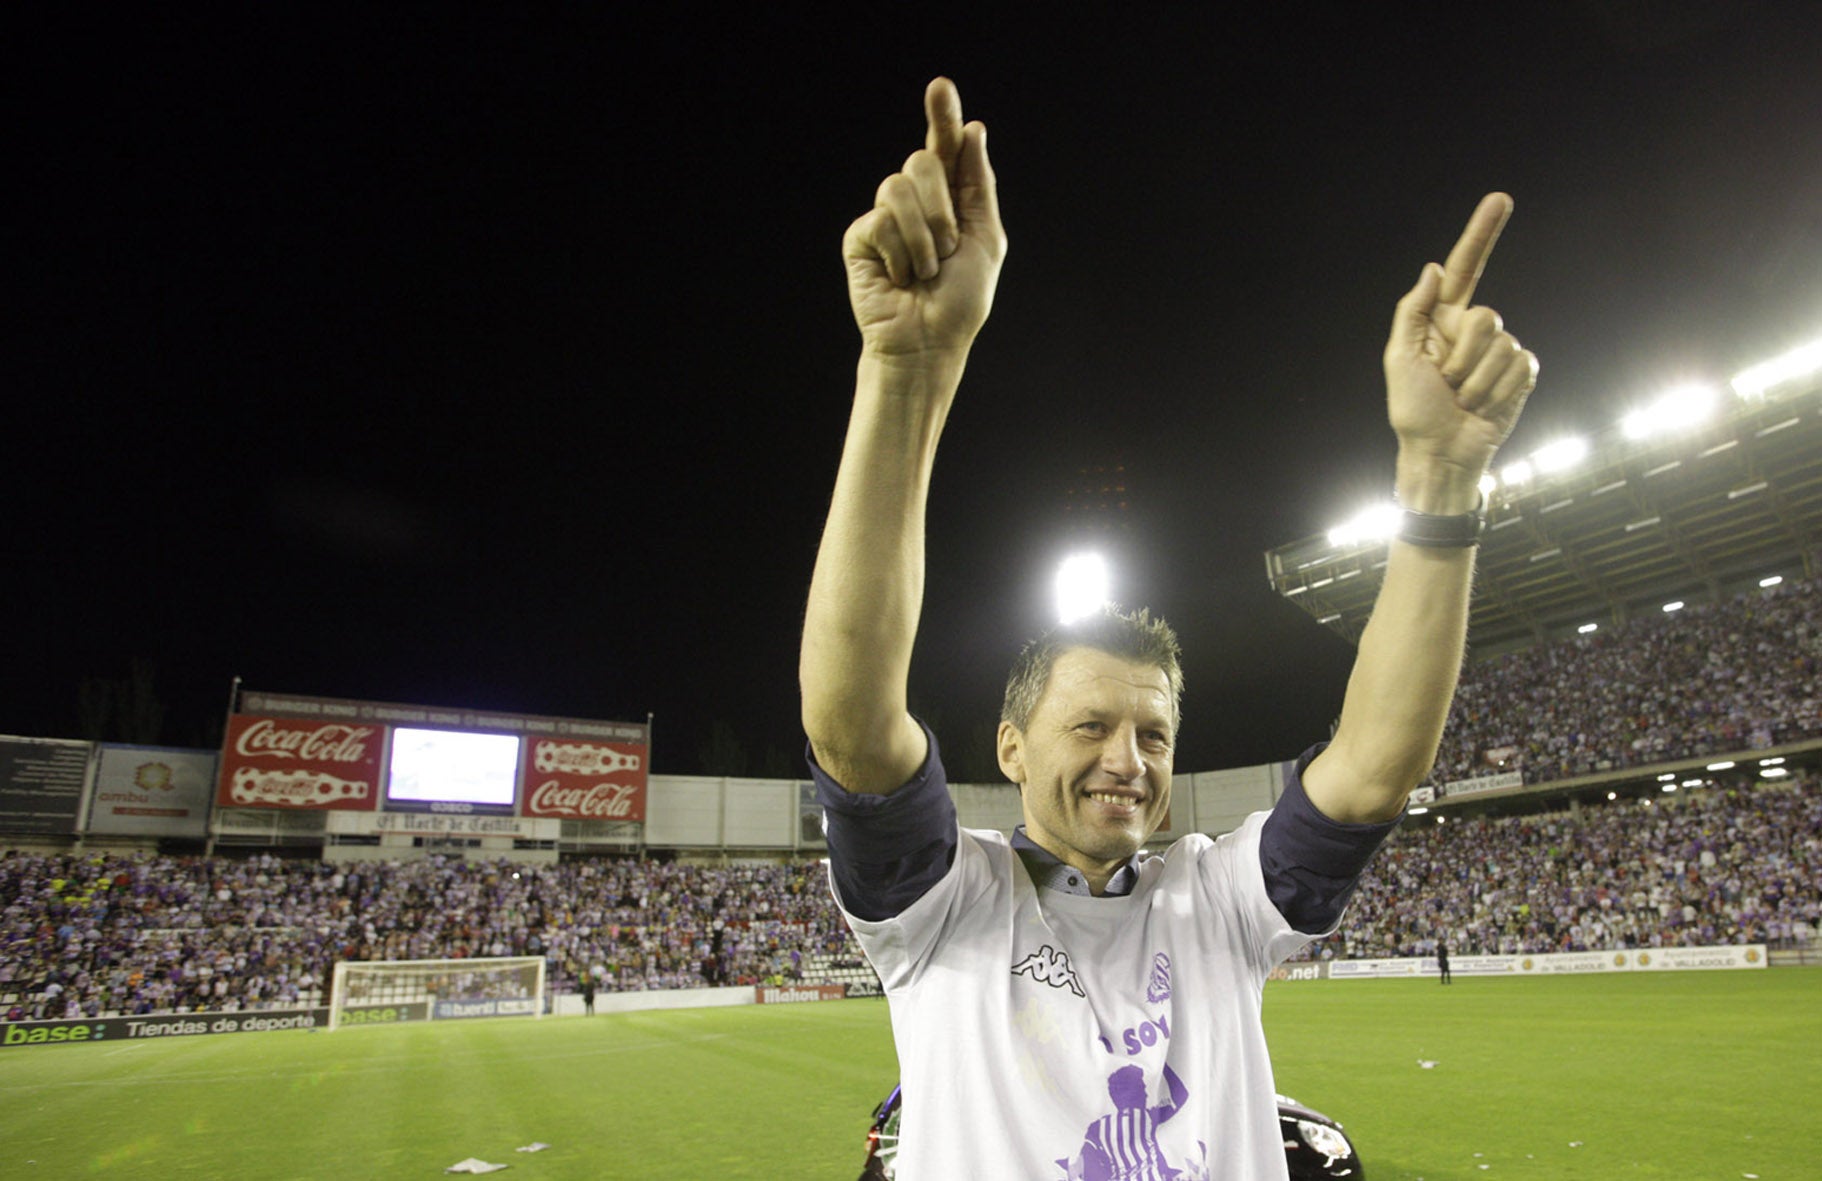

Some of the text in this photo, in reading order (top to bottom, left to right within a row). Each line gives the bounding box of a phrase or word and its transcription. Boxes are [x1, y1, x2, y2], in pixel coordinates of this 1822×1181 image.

[236, 720, 374, 761] Coca-Cola
[530, 780, 638, 816] Coca-Cola
[127, 1020, 207, 1037] Tiendas
[211, 1018, 239, 1033] de
[241, 1015, 315, 1032] deporte
[1123, 1014, 1170, 1055] SOY
